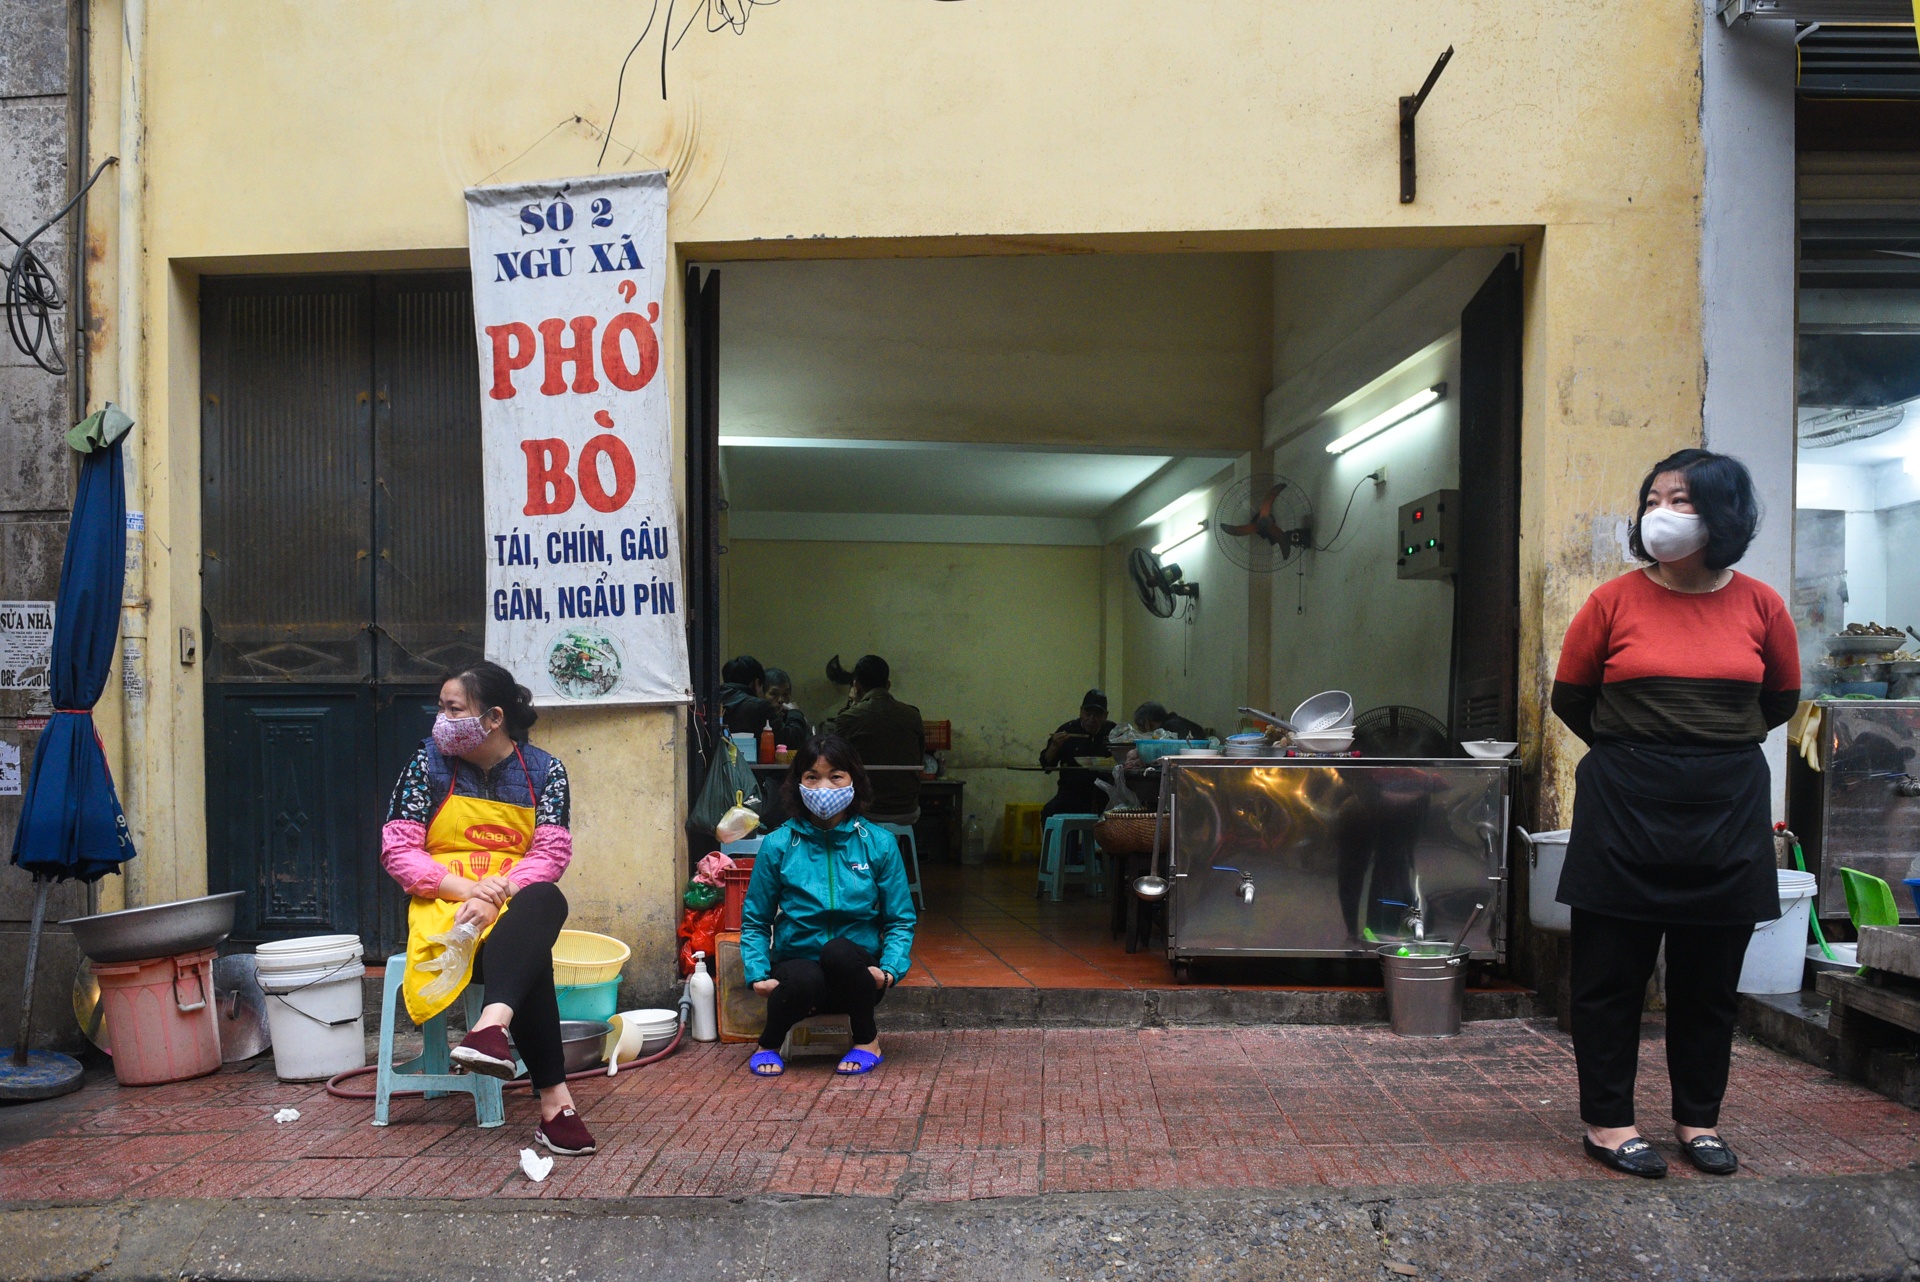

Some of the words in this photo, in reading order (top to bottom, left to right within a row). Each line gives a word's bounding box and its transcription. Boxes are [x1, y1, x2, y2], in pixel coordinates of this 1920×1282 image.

[520, 184, 574, 236] SỐ
[591, 197, 614, 229] 2
[494, 238, 576, 282] NGŨ
[588, 234, 645, 274] XÃ
[485, 279, 659, 400] PHỞ
[520, 409, 636, 516] BÒ
[494, 527, 538, 569] TÁI,
[547, 523, 612, 565] CHÍN,
[620, 516, 669, 561] GẦU
[0, 609, 24, 629] SỬA
[27, 609, 52, 629] NHÀ
[493, 582, 550, 624] GÂN,
[558, 571, 625, 619] NGẨU
[634, 575, 675, 616] PÍN
[472, 830, 516, 842] Maggi
[851, 862, 870, 871] FILA
